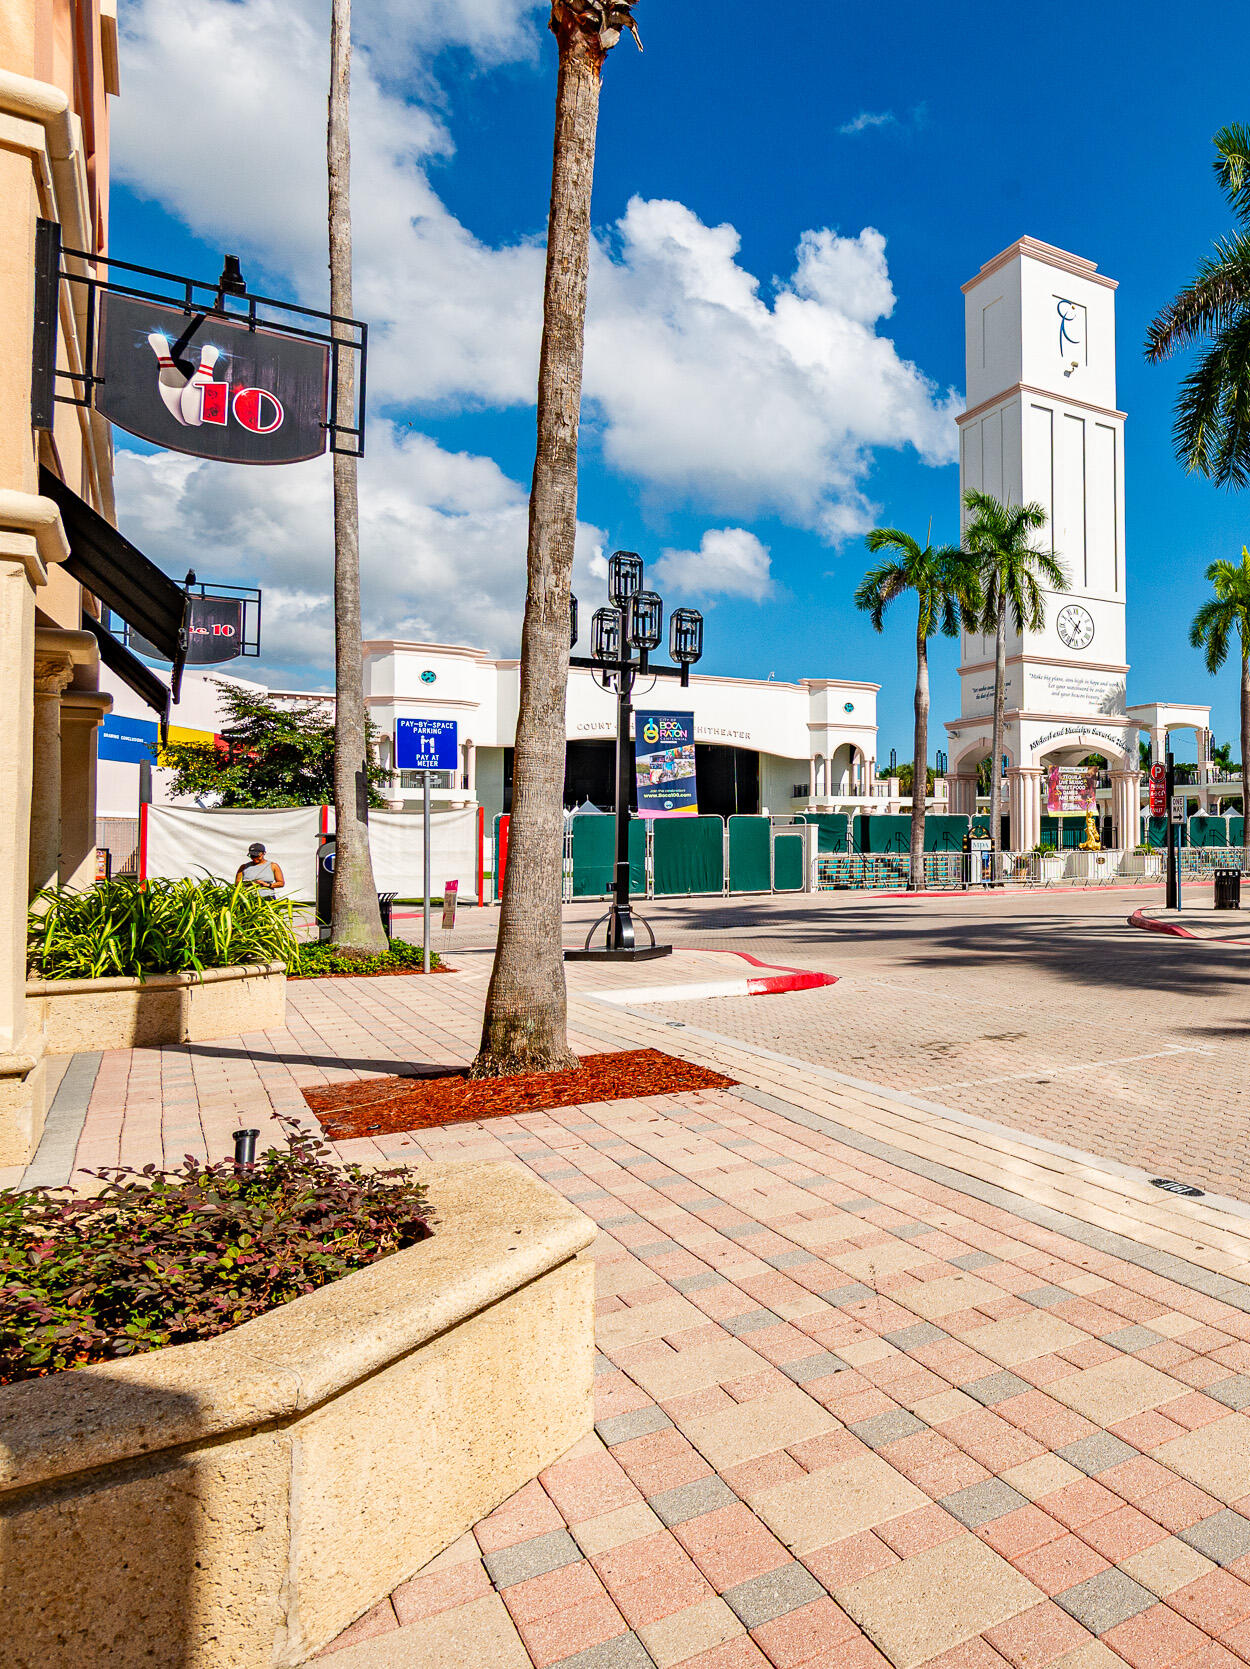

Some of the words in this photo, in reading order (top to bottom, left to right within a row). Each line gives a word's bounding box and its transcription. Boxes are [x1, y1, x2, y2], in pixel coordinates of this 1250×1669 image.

[192, 382, 284, 434] 10
[211, 624, 235, 637] 10
[400, 720, 454, 729] PAY-BY-SPACE
[660, 721, 682, 730] BOCA
[413, 727, 442, 735] PARKING
[660, 729, 688, 738] RATON
[1154, 766, 1162, 778] P
[1172, 797, 1183, 806] ONE
